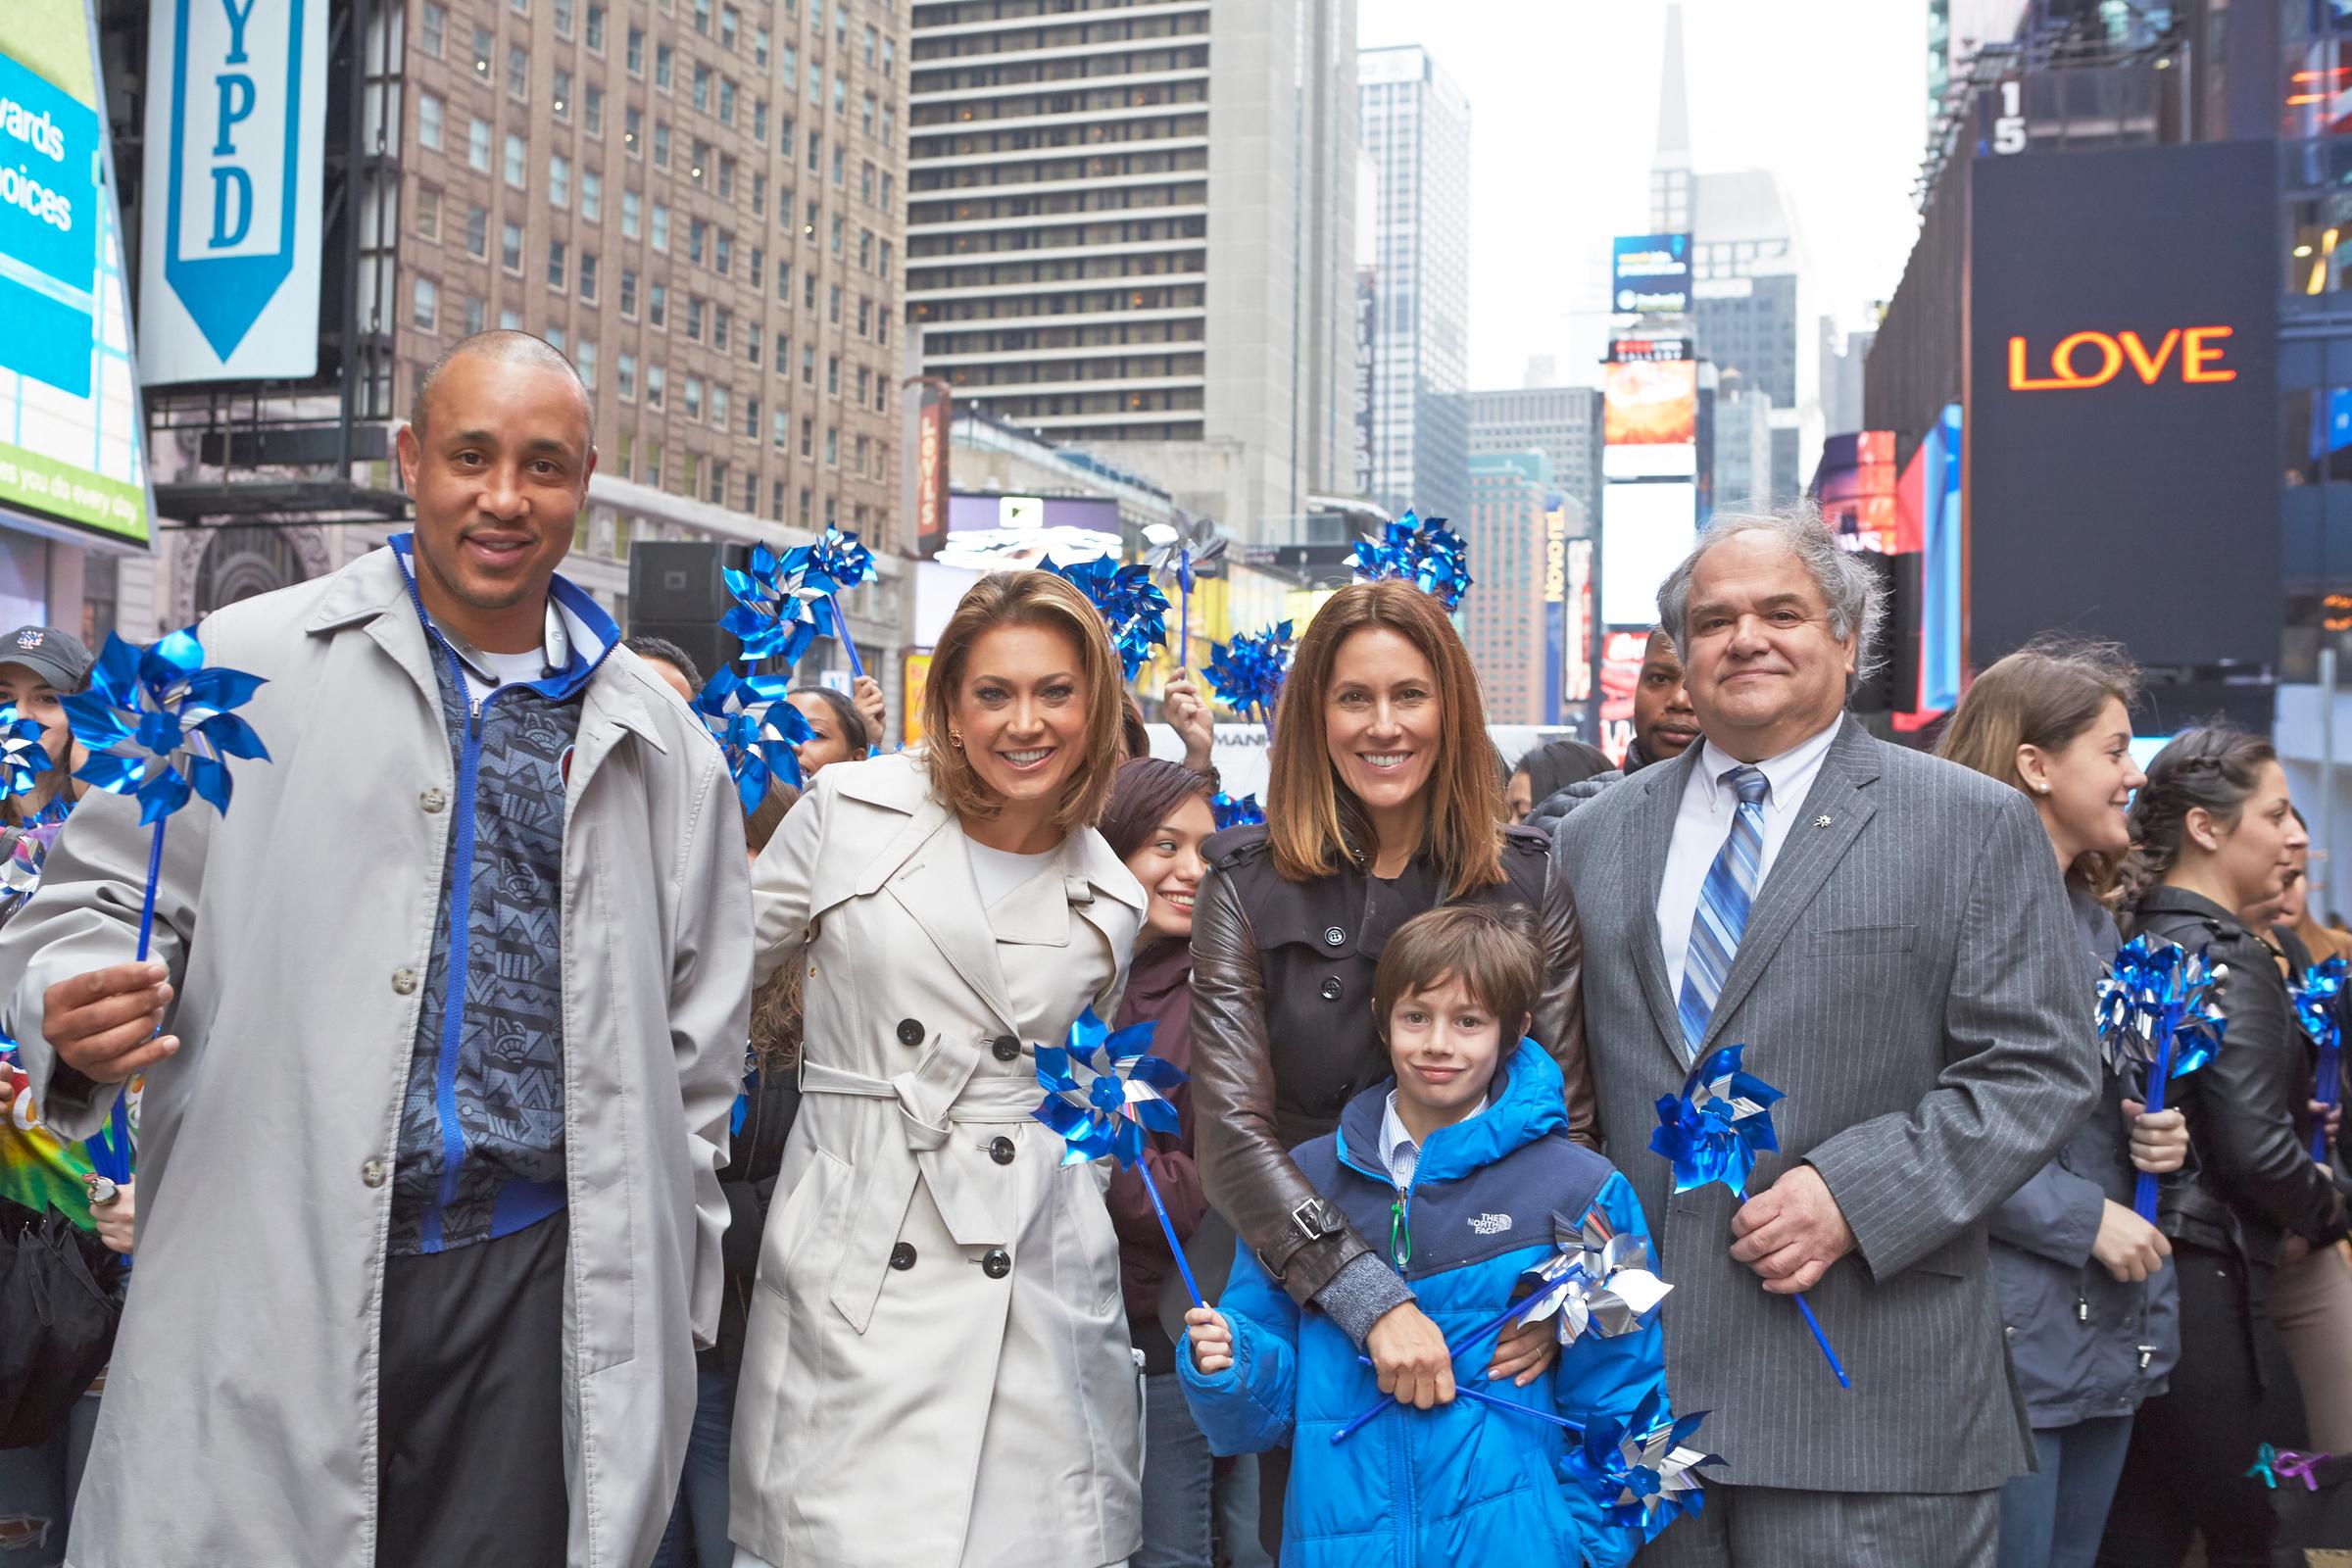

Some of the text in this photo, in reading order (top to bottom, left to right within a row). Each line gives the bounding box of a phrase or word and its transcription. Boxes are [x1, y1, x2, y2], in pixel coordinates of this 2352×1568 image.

[0, 163, 72, 232] oices
[2008, 325, 2237, 391] LOVE
[1468, 1217, 1498, 1228] NORTH
[1481, 1213, 1499, 1222] THE
